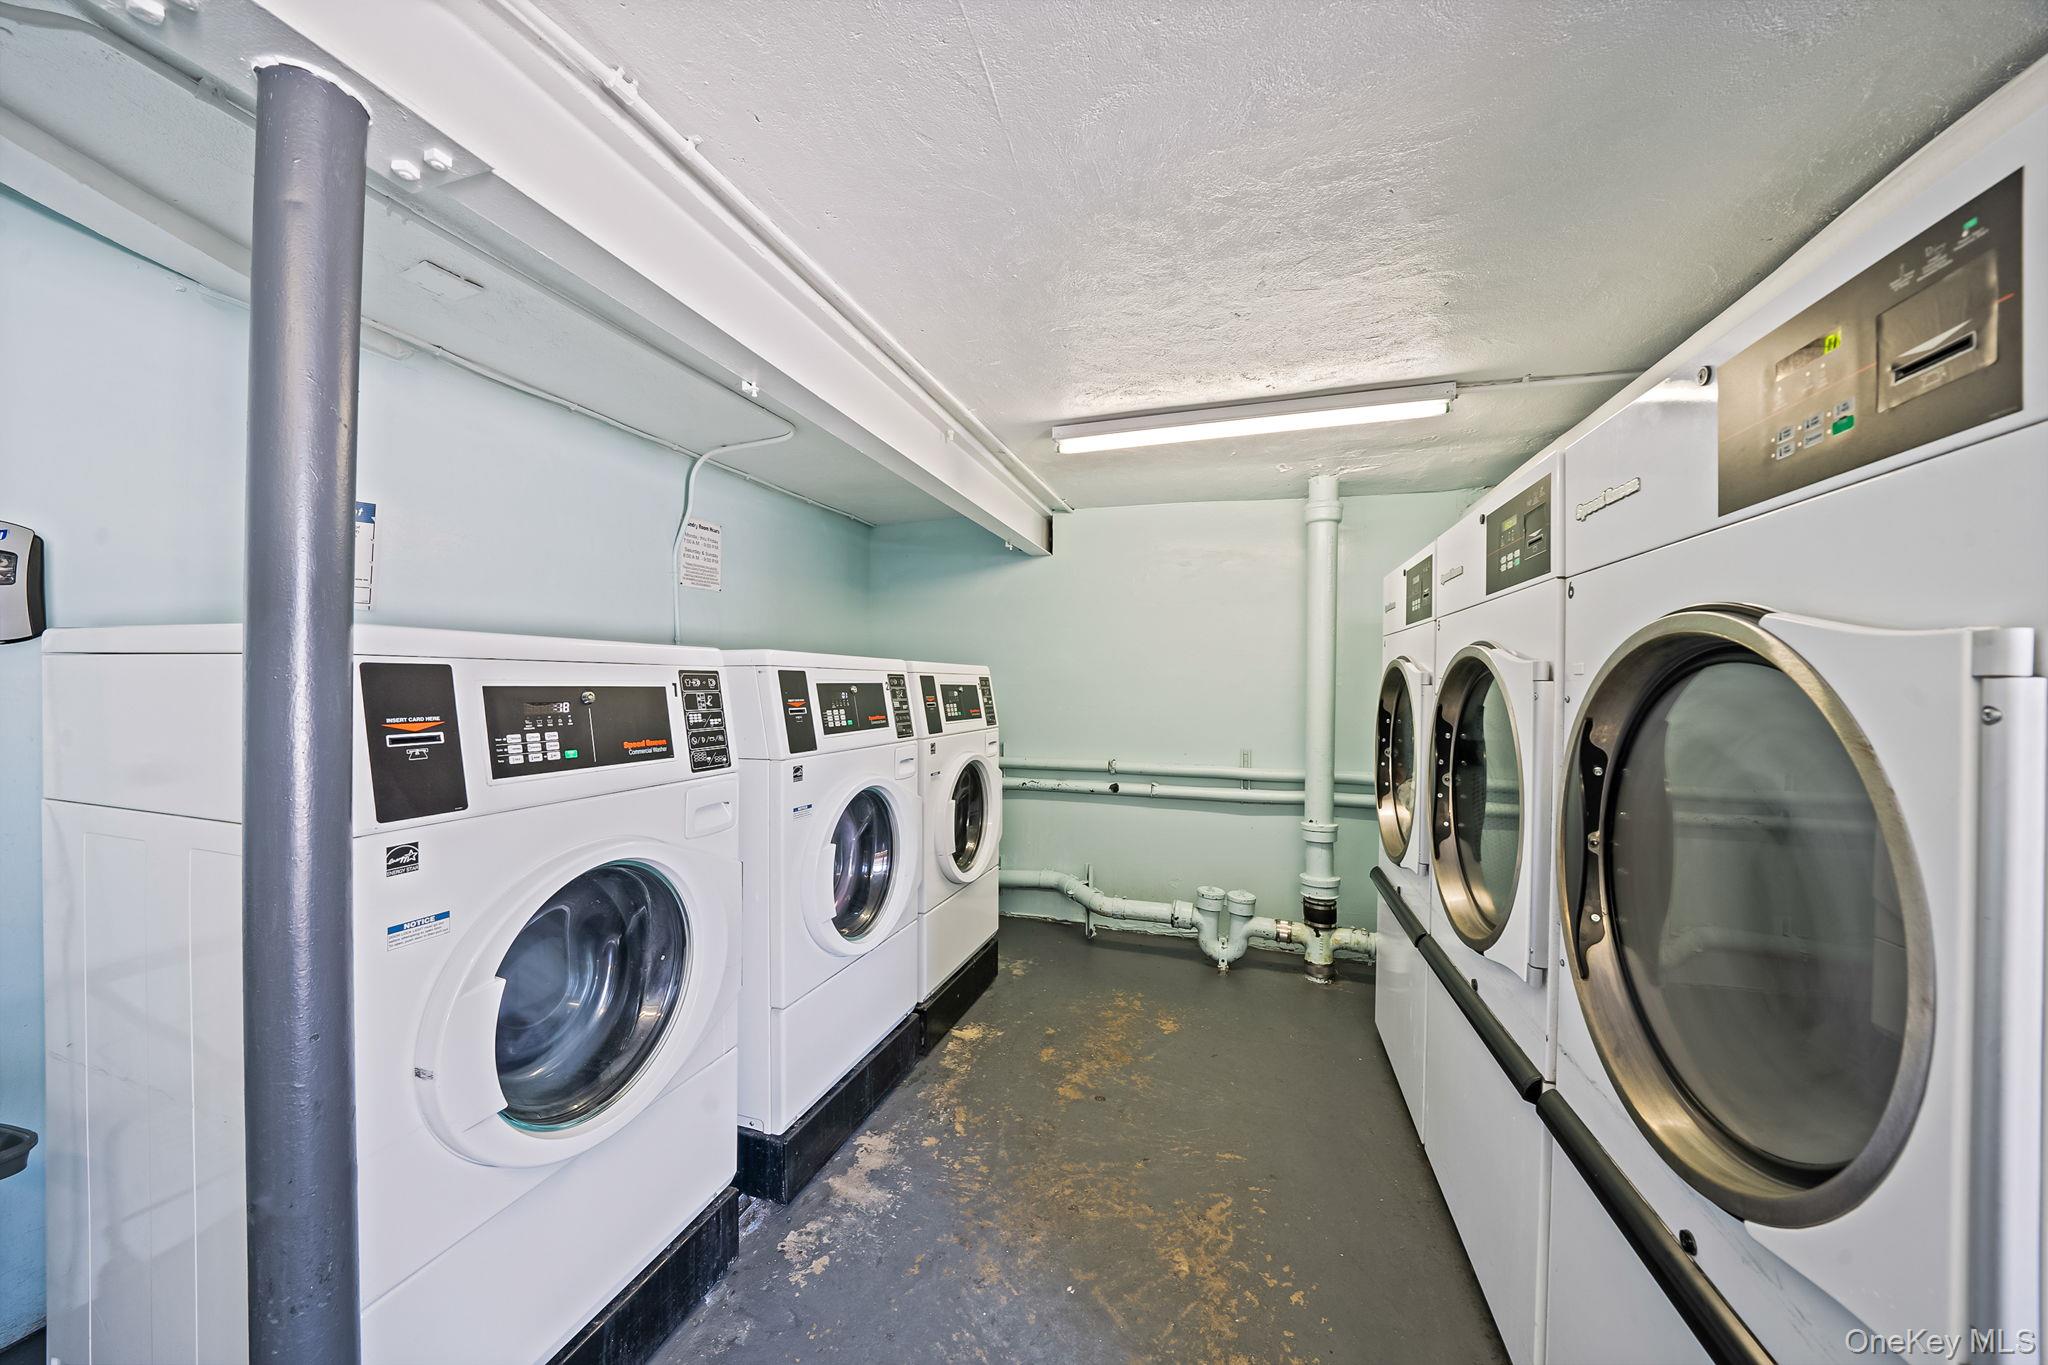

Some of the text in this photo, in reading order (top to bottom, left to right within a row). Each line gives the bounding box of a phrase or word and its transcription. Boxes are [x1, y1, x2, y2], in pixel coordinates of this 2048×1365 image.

[1568, 581, 1574, 599] 6
[672, 683, 678, 697] 1
[624, 740, 645, 749] Speed
[628, 748, 652, 756] Commercial
[386, 865, 419, 876] ENERGY STAR
[403, 915, 436, 930] NOTICE
